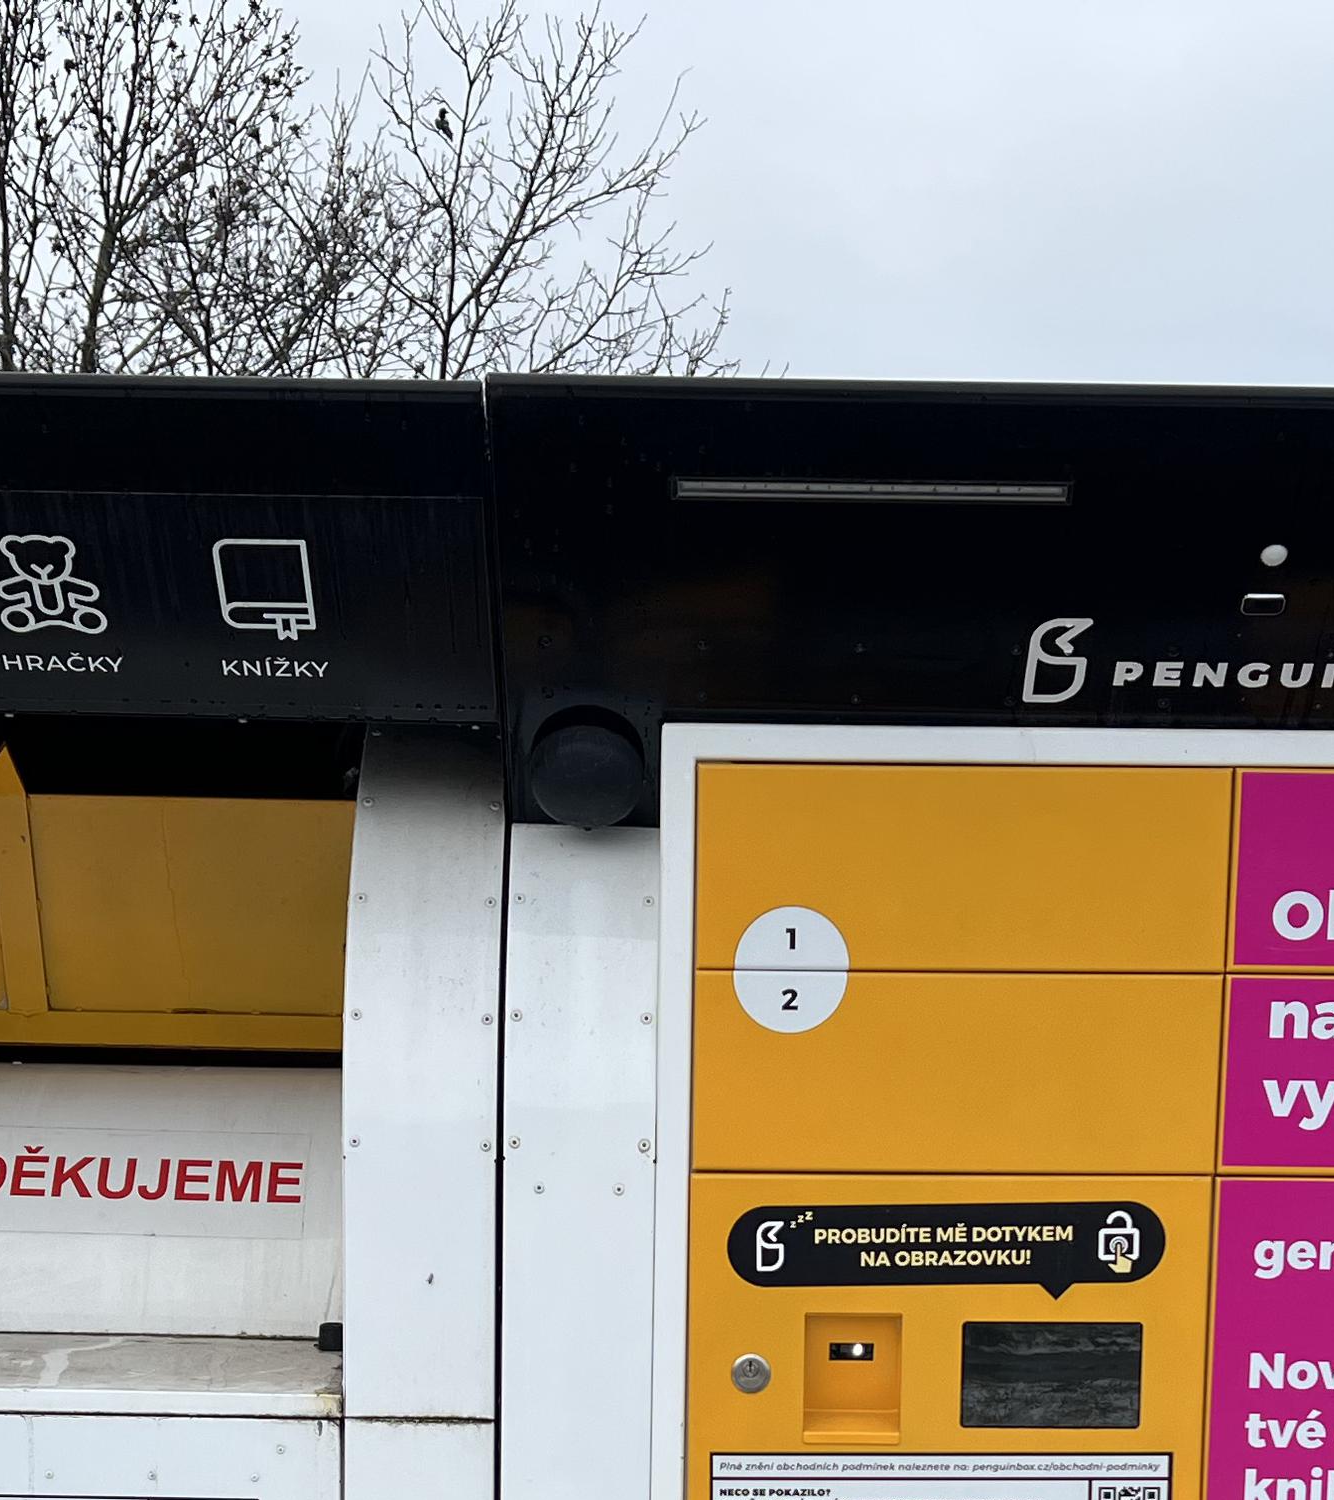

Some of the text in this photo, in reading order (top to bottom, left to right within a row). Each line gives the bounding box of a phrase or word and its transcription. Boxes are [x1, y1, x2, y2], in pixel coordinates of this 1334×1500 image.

[2, 652, 122, 672] HRAČKY
[222, 657, 328, 677] KNÍŽKY
[786, 928, 795, 949] 1
[782, 989, 798, 1010] 2
[815, 1223, 1073, 1244] PROBUDÍTE MĚ DOTYKEM
[861, 1250, 1030, 1266] NA OBRAZOVKU!
[1245, 1410, 1326, 1448] tvé
[719, 1462, 743, 1471] Plné
[745, 1462, 774, 1471] znění
[776, 1462, 839, 1471] obchodních
[842, 1462, 895, 1473] podmínek
[898, 1463, 950, 1472] naleznete
[953, 1464, 970, 1472] na:
[753, 1488, 766, 1497] SE
[768, 1488, 831, 1497] POKAZILO?
